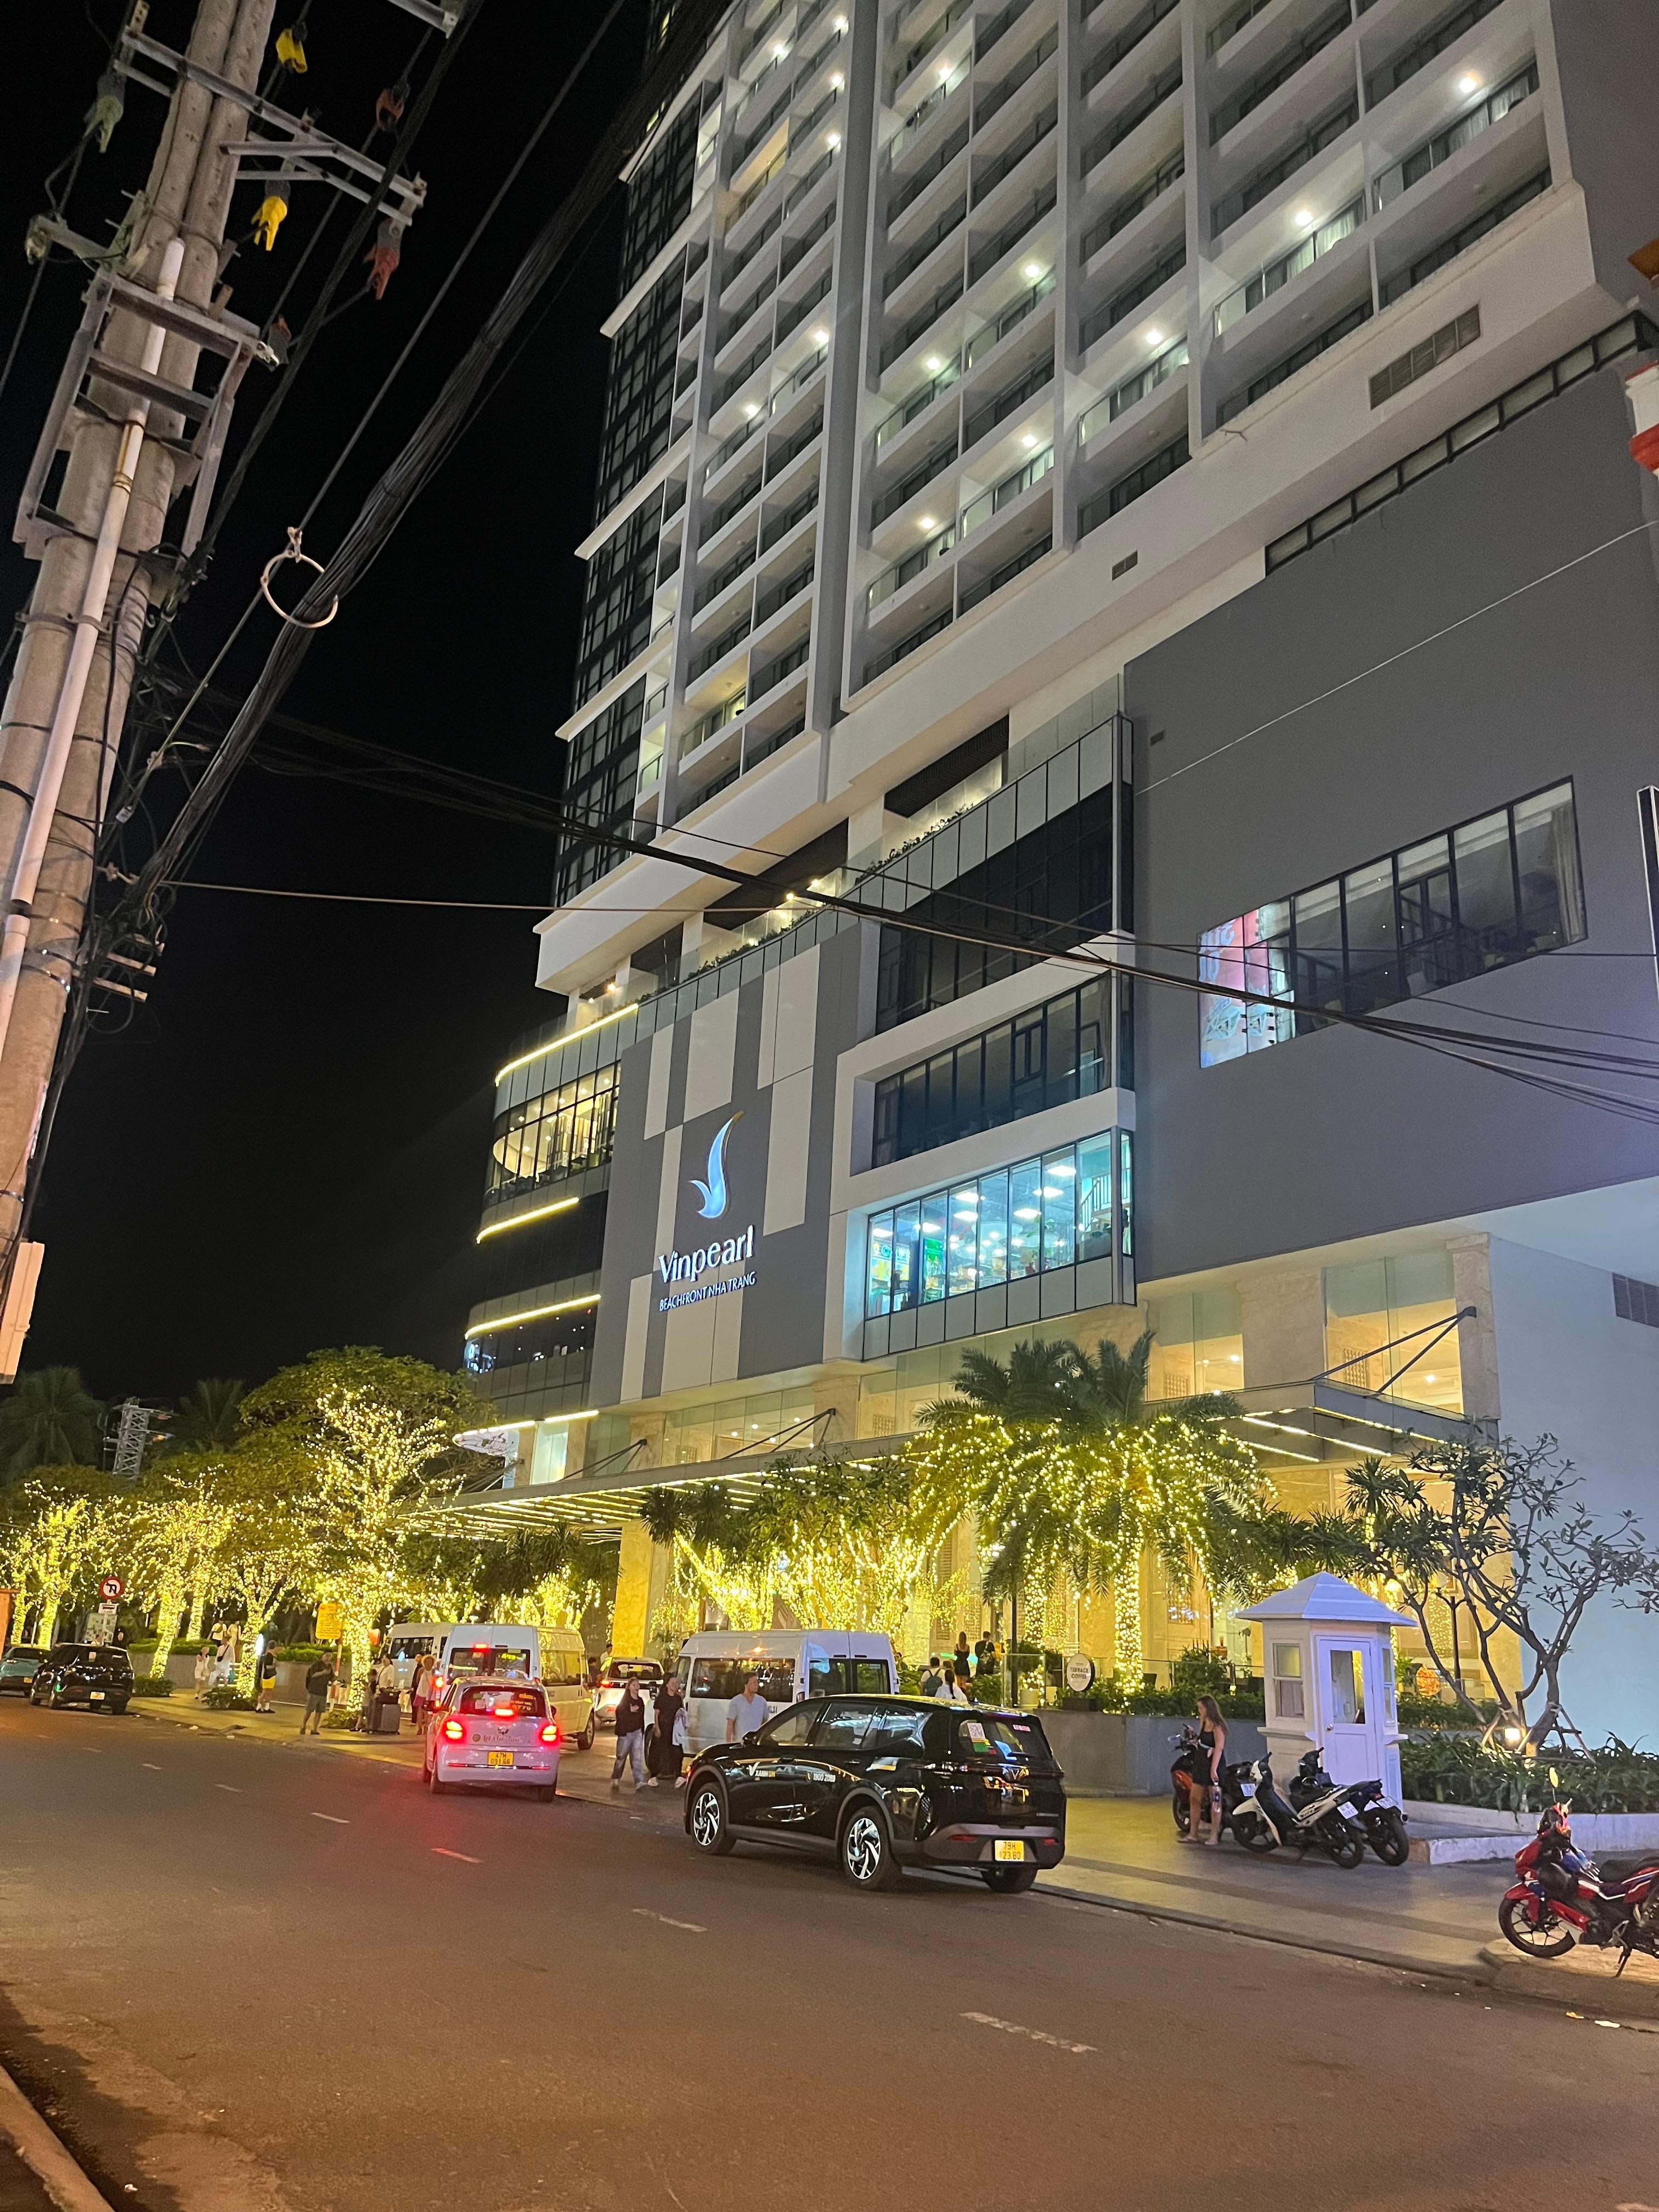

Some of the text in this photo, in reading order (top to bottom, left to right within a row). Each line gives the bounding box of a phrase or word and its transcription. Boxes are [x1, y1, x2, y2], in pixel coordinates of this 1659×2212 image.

[658, 1224, 754, 1283] Vinpearl
[659, 1271, 756, 1312] BEACHFRONT NHA TRANG
[1003, 1841, 1016, 1850] 79H
